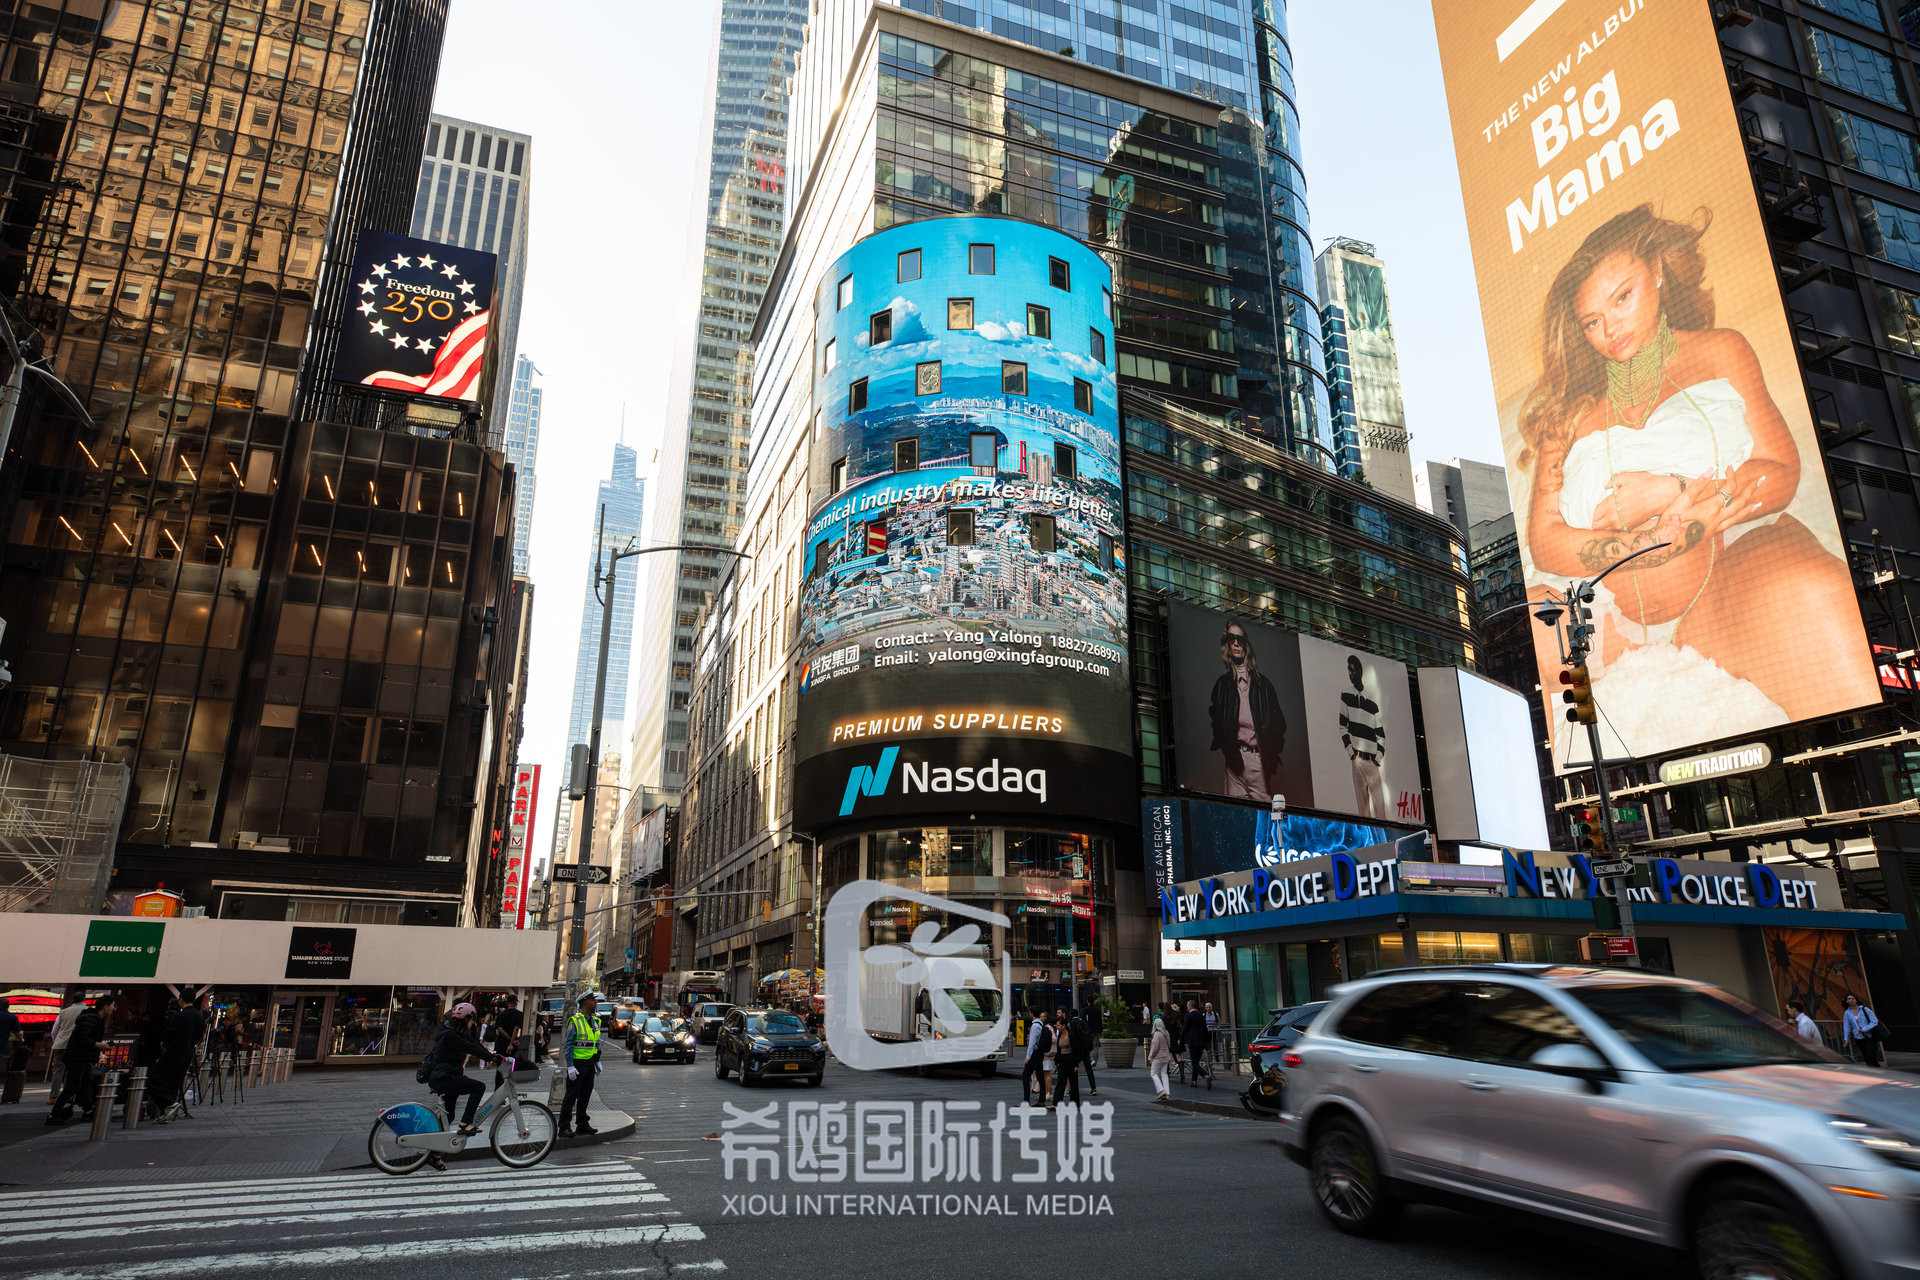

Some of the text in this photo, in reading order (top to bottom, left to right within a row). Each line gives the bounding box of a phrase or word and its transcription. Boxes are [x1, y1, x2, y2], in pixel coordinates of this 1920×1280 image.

[1482, 0, 1643, 143] THE NEW ALBU
[1530, 69, 1621, 169] Big
[1505, 98, 1680, 254] Mama
[386, 278, 456, 300] Freedom
[382, 291, 453, 322] 250
[860, 483, 945, 512] industry
[951, 482, 1025, 500] makes
[1032, 484, 1063, 506] life
[1069, 491, 1113, 523] better
[811, 644, 860, 679] 兴发集团
[874, 630, 1121, 664] Contact: Yang Yalong 18827268921
[874, 647, 1110, 677] Email: yalong@xingfagroup.com
[810, 664, 860, 688] XINGFA GROUP
[833, 713, 1063, 742] PREMIUM SUPPLIERS
[902, 758, 1047, 803] Nasdaq
[513, 772, 531, 825] PARK
[1397, 790, 1421, 821] H&M
[1153, 806, 1163, 867] AMERICAN
[503, 857, 521, 912] PARK
[1595, 864, 1628, 874] ONE WAY
[892, 905, 911, 913] Nasdaq
[1026, 906, 1047, 914] Nasdaq
[89, 945, 143, 953] STARBUCKS
